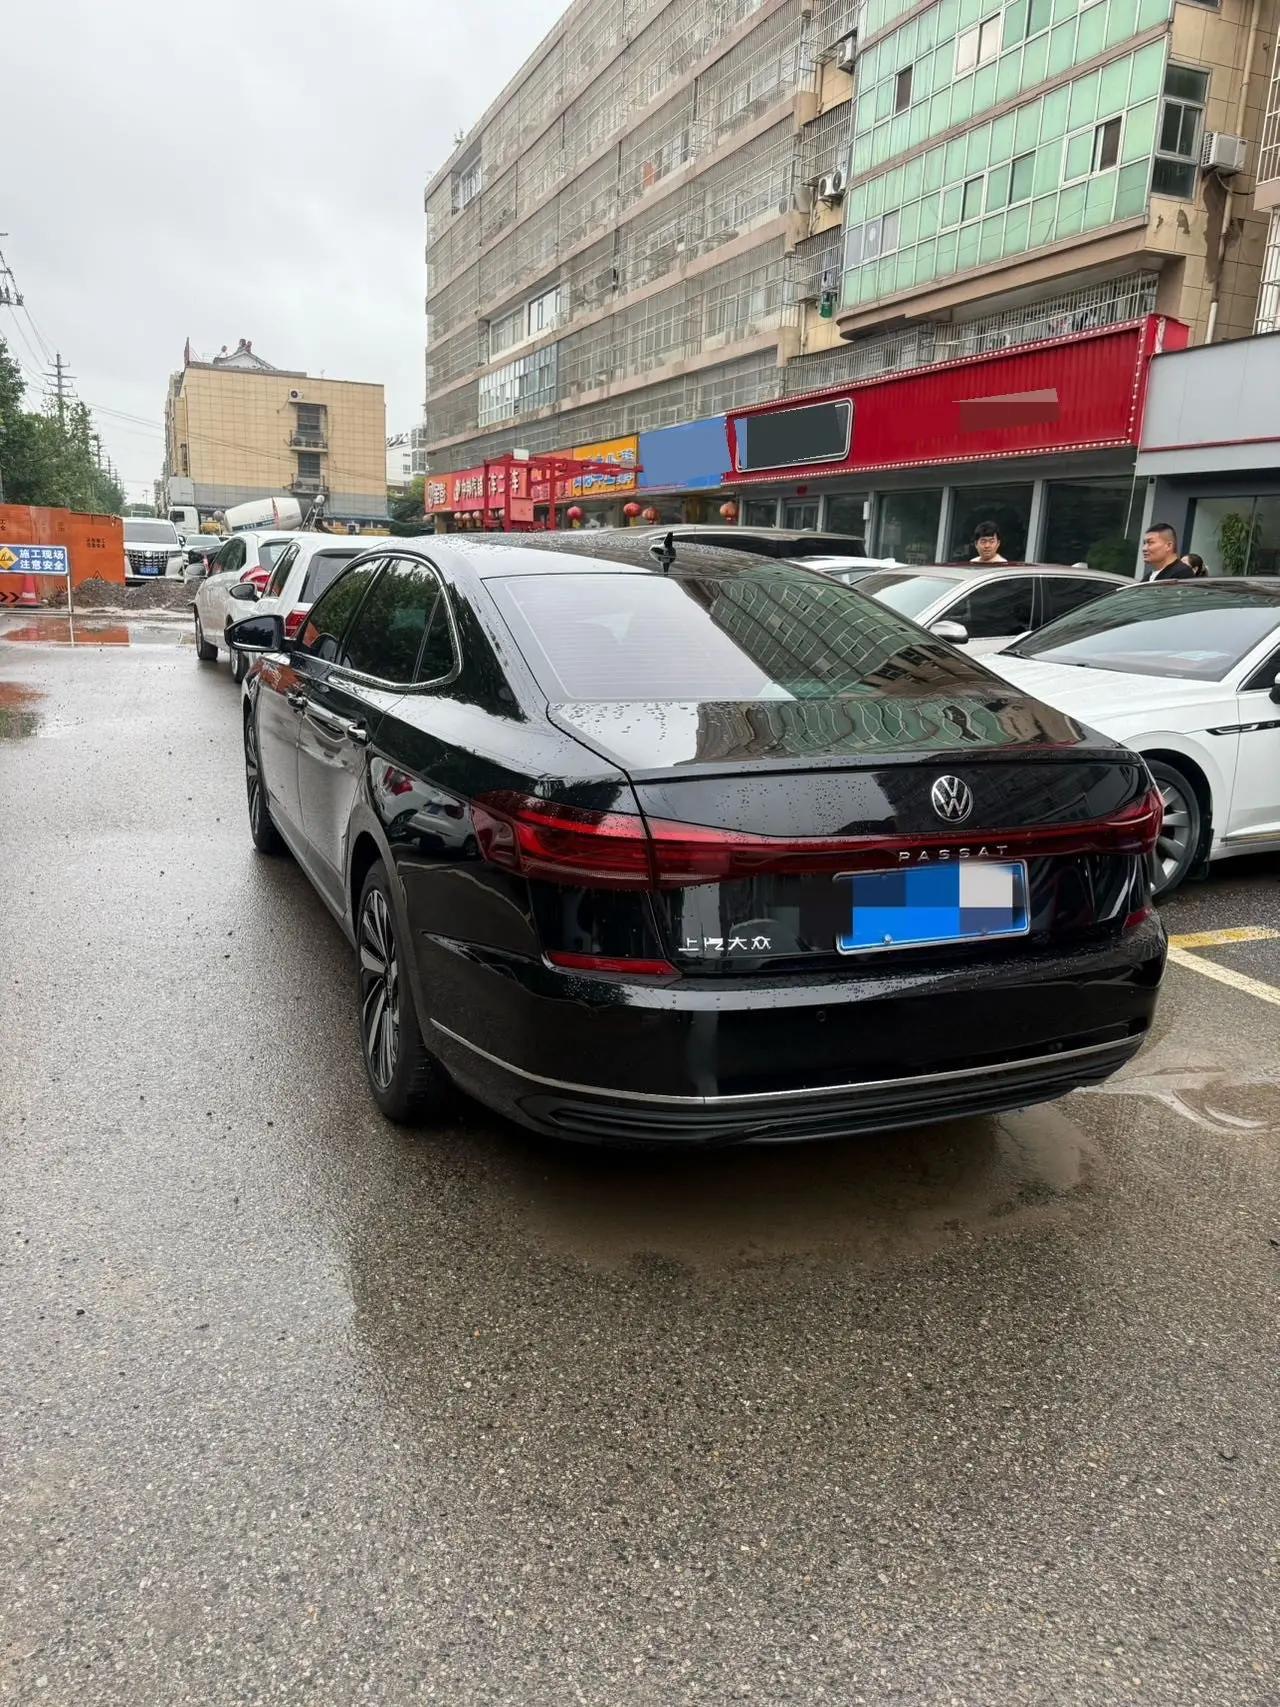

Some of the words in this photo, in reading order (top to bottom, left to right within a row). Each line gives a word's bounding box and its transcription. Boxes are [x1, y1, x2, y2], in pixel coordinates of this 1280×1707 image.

[19, 548, 65, 560] 施工现场
[19, 560, 65, 571] 注意安全
[898, 844, 1009, 863] PASSAT
